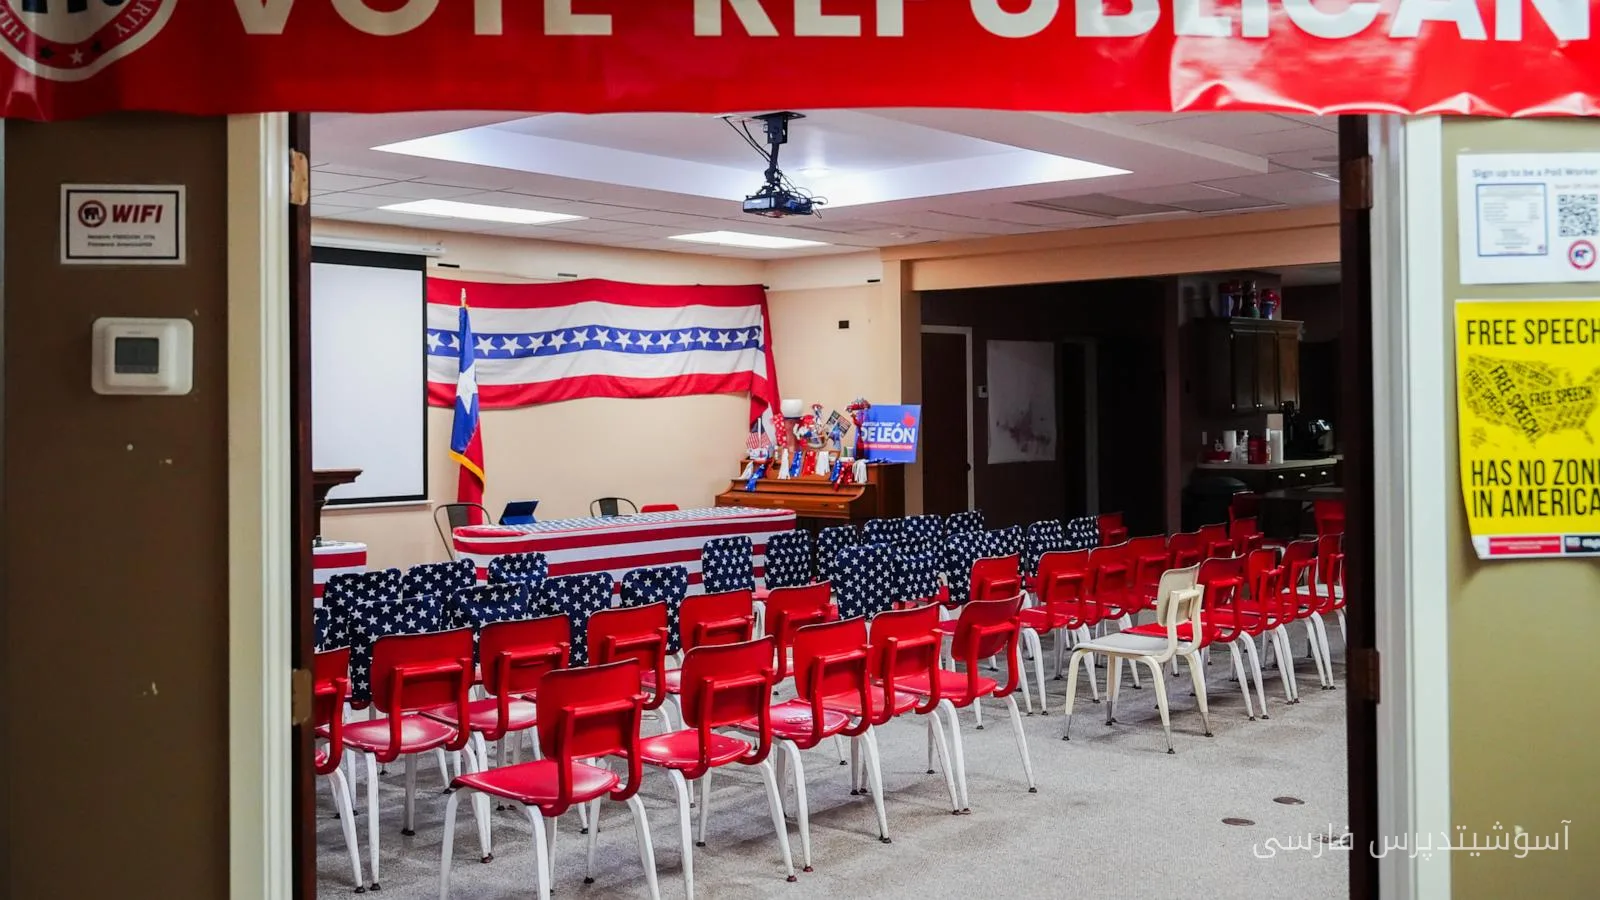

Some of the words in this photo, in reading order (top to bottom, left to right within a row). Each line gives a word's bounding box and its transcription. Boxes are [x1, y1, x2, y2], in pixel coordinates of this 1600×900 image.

[113, 0, 157, 37] RTY
[112, 204, 163, 224] WIFI
[1467, 319, 1517, 345] FREE
[1489, 365, 1516, 397] FREE
[1506, 393, 1541, 438] SPEECH
[1529, 390, 1553, 407] FREE
[1555, 385, 1593, 404] SPEECH
[877, 422, 916, 443] LEÓN
[1472, 459, 1513, 486] HAS
[1519, 459, 1545, 486] NO
[1473, 489, 1492, 518] IN
[1501, 488, 1600, 517] AMERICA
